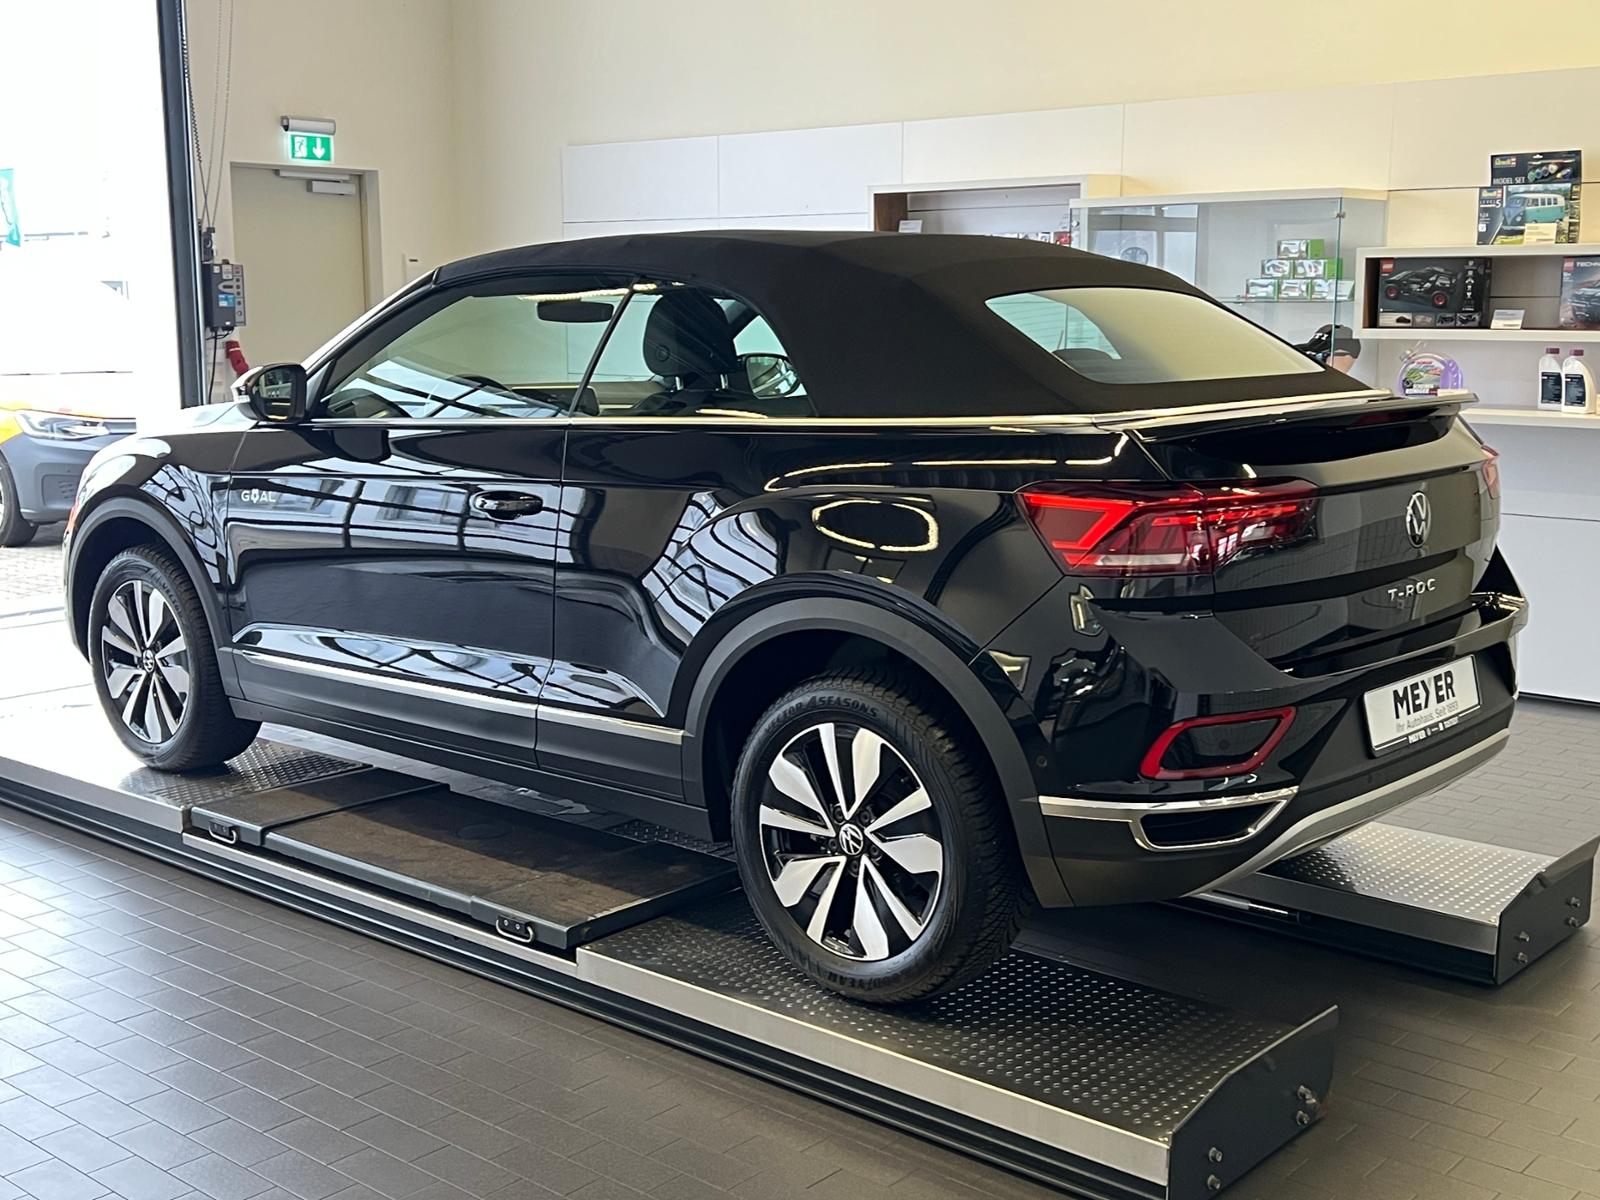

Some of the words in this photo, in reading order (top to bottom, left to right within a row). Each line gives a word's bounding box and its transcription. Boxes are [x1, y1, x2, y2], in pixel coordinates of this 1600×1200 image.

[1493, 177, 1513, 185] MODEL
[1514, 176, 1526, 184] SET
[1315, 332, 1329, 341] TI
[241, 488, 276, 504] GOAL
[1388, 578, 1436, 601] T-ROC
[1392, 670, 1456, 720] MEYER
[807, 695, 880, 718] 4SEASONS
